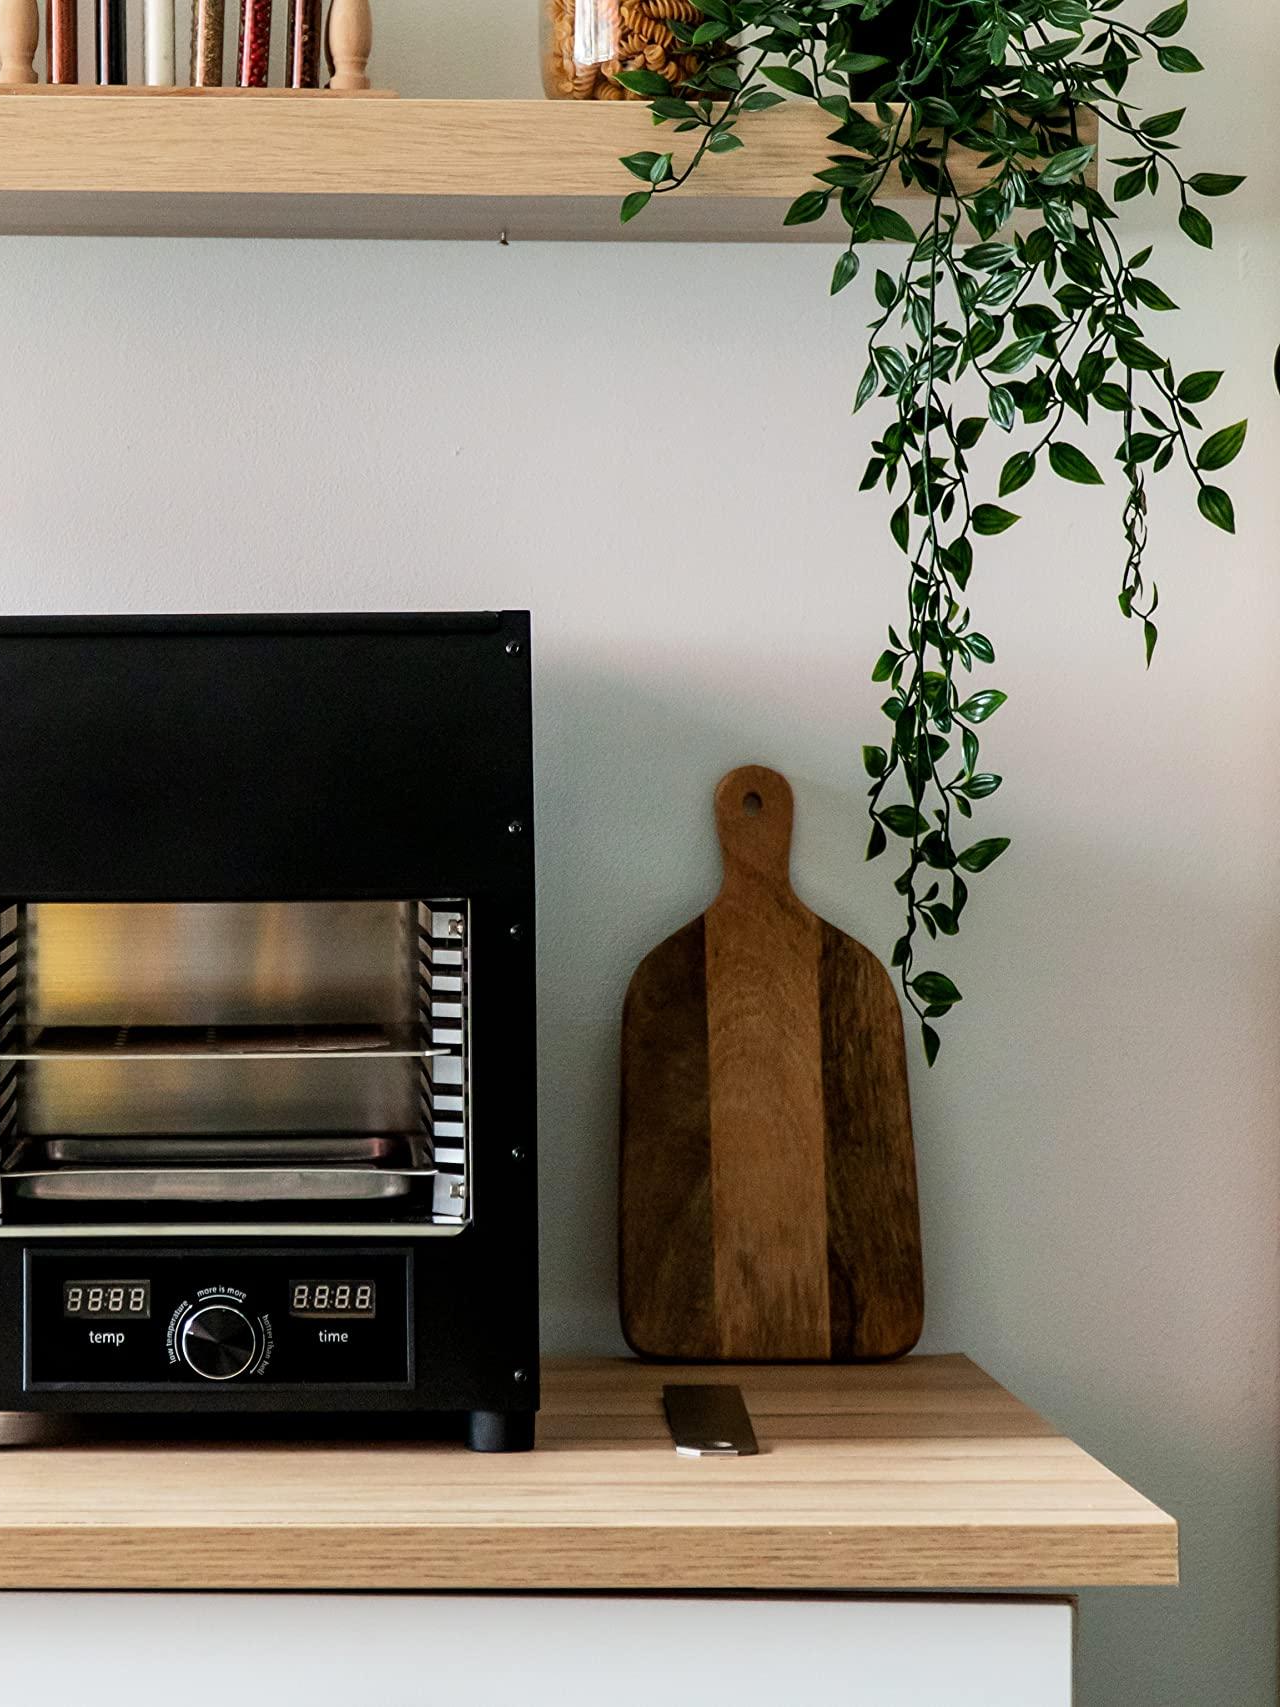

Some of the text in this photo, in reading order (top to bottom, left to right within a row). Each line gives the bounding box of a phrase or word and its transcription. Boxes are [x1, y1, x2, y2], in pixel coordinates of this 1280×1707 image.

[197, 1284, 247, 1299] more is more
[166, 1300, 188, 1364] low temperature
[262, 1314, 273, 1339] hotter
[89, 1330, 125, 1347] temp
[319, 1330, 349, 1343] time
[265, 1341, 275, 1359] than
